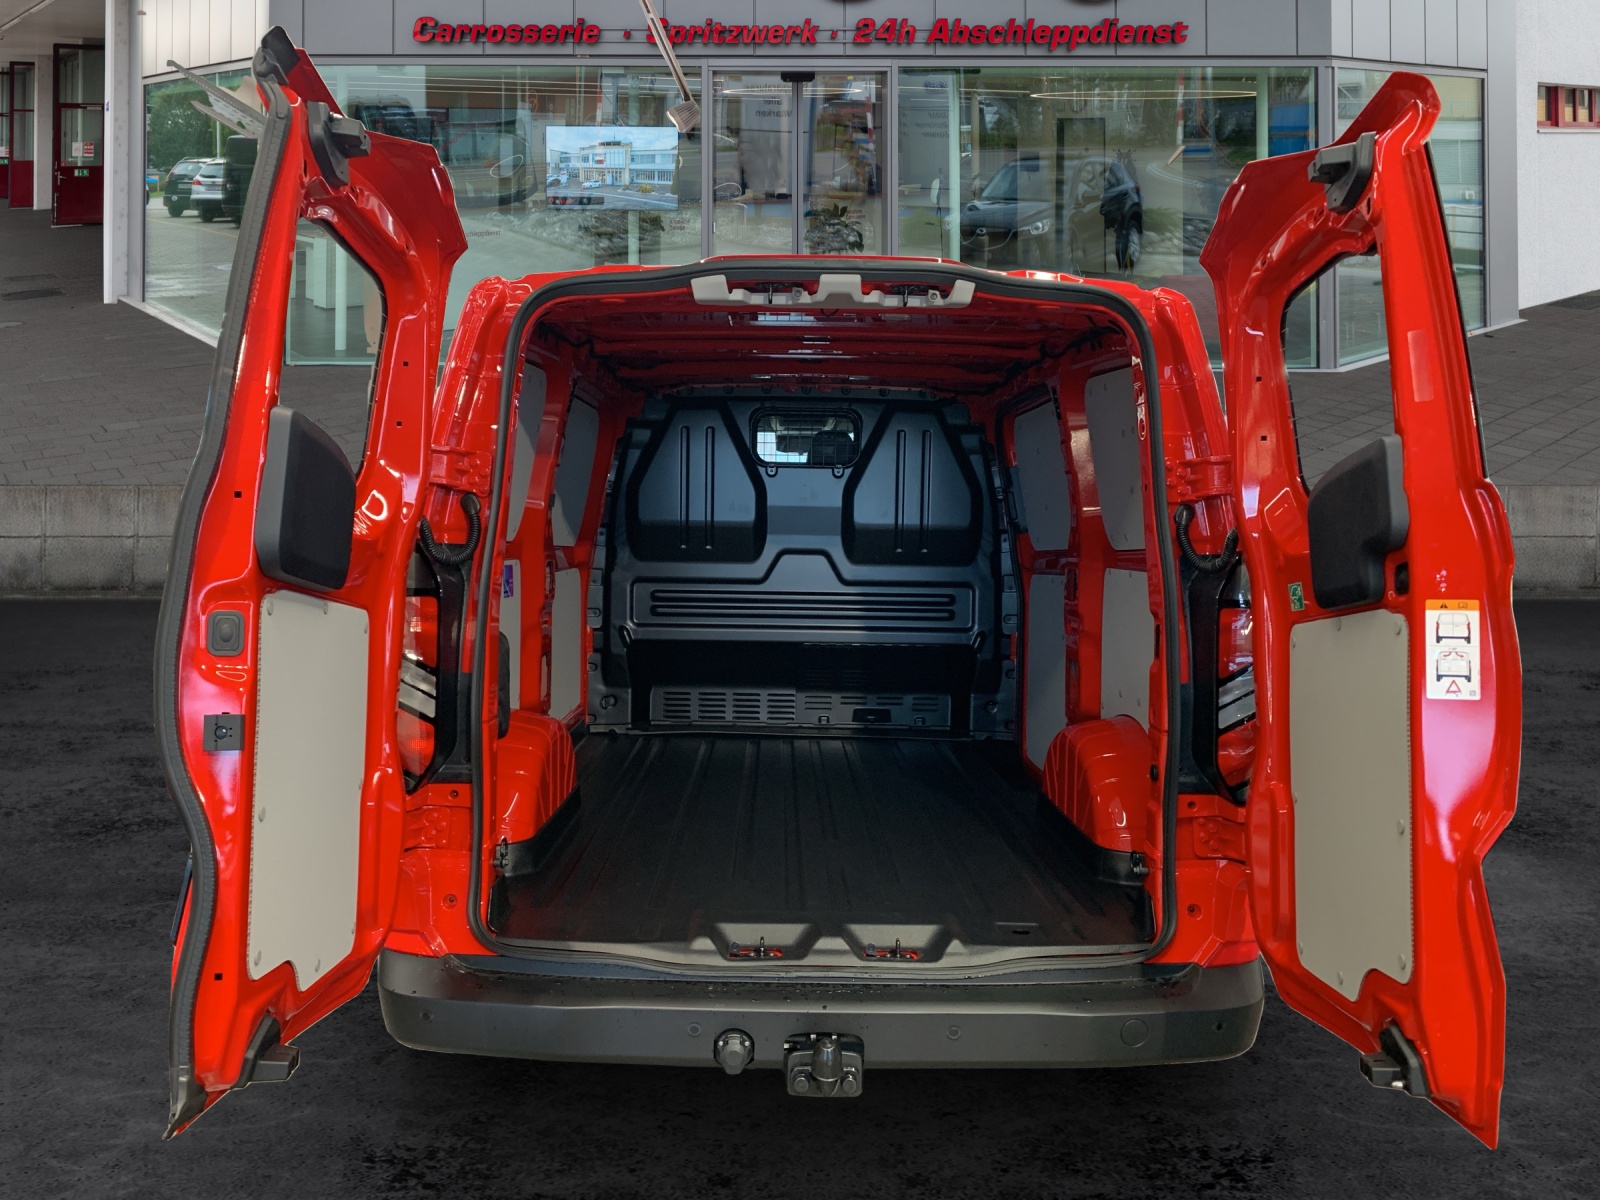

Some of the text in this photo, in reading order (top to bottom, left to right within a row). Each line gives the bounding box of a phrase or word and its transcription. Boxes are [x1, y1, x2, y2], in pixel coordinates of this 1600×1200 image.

[412, 16, 1189, 51] Carrosserie Spritzwerk 24h Abschleppdienst
